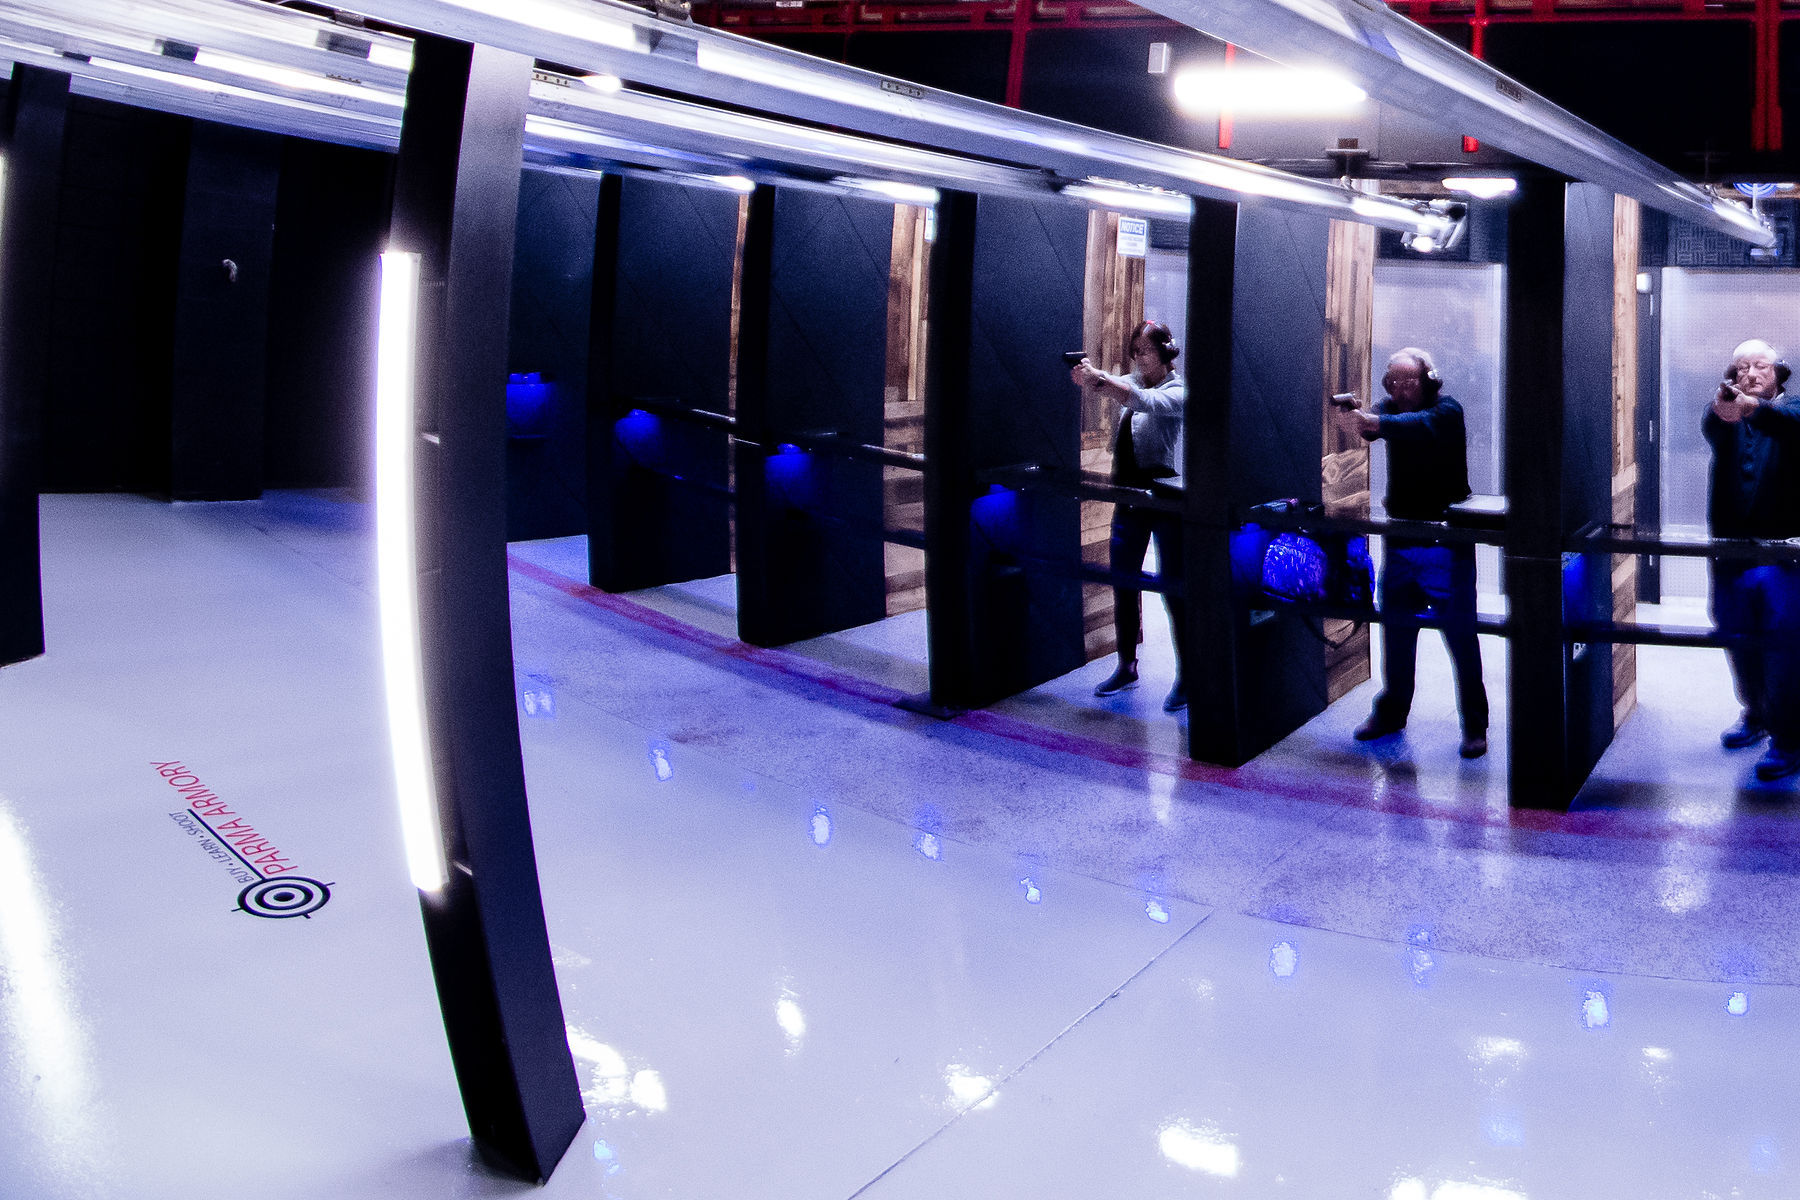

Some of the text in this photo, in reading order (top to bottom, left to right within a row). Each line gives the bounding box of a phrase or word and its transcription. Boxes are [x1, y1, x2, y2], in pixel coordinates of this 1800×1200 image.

[1121, 221, 1144, 234] NOTICE
[150, 761, 298, 874] PARMA ARMORY
[168, 811, 254, 883] BUY LEARN SHOOT
